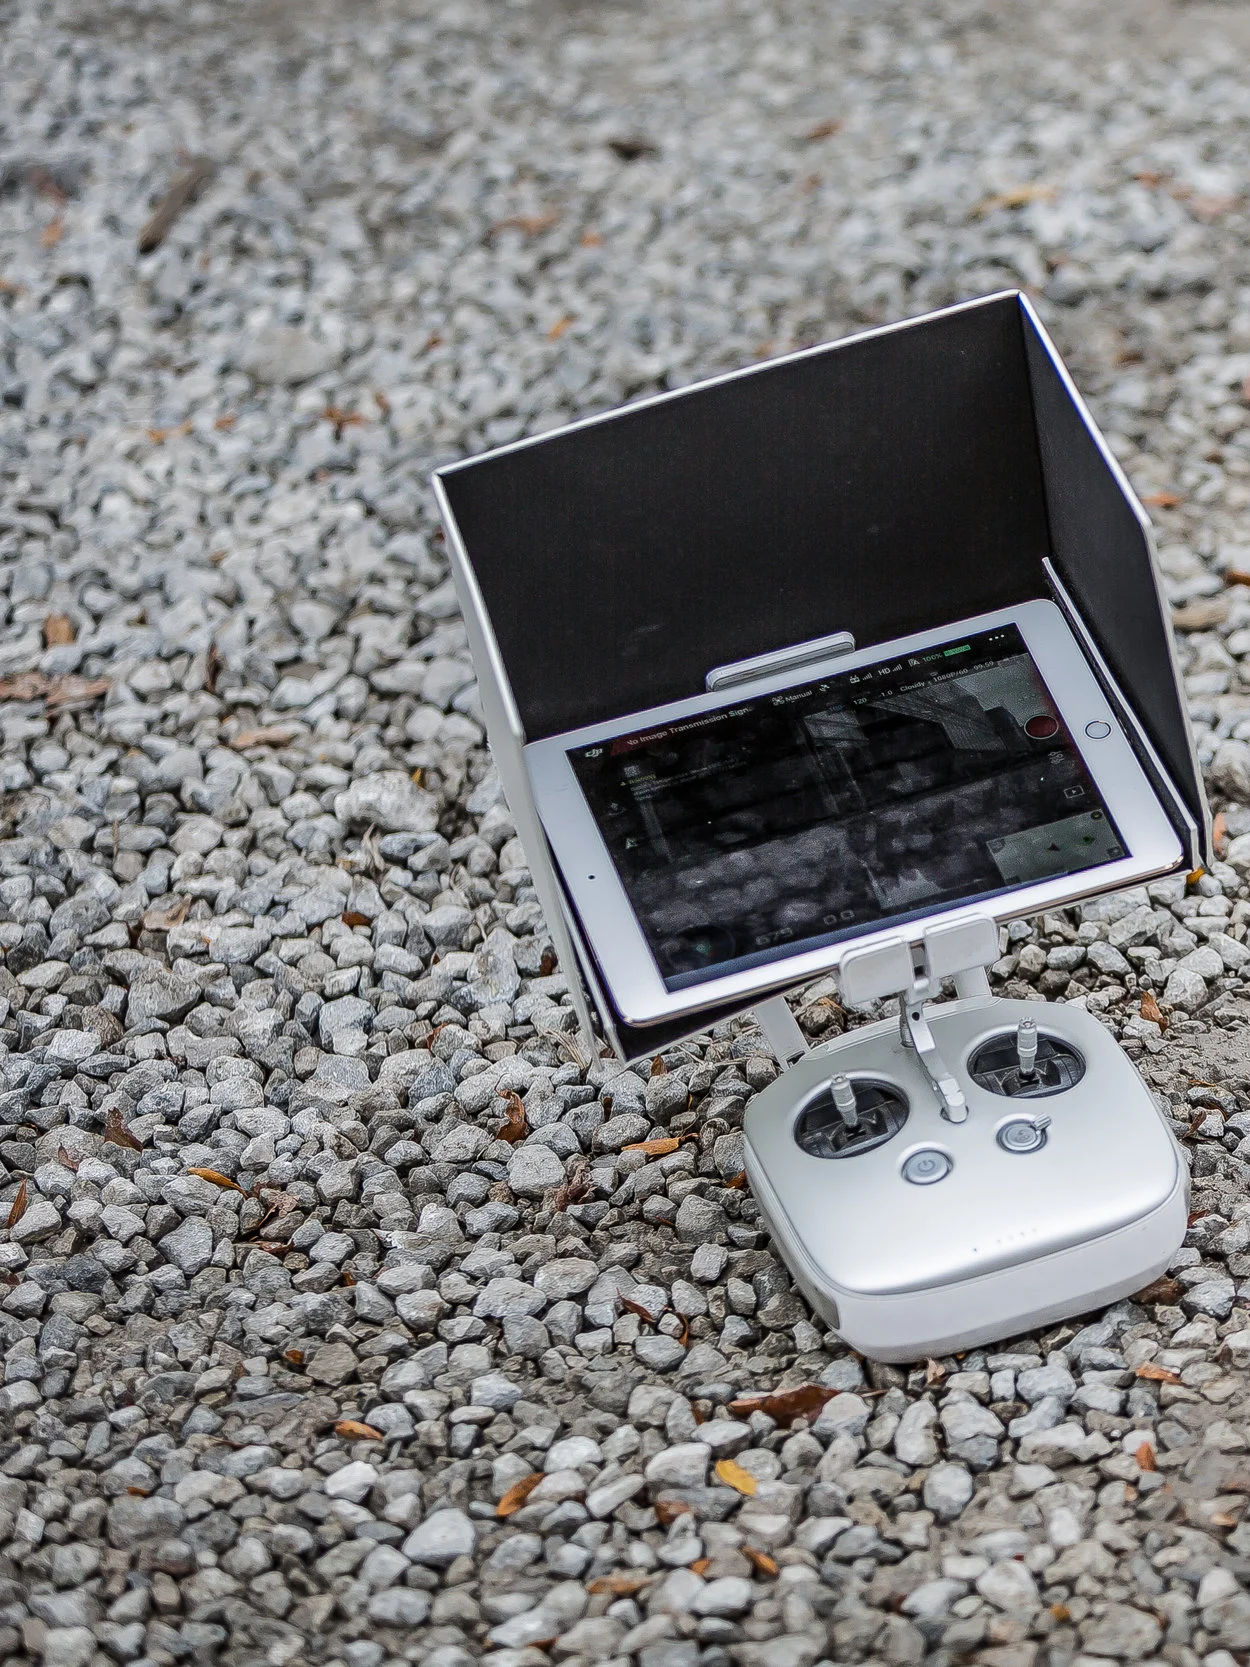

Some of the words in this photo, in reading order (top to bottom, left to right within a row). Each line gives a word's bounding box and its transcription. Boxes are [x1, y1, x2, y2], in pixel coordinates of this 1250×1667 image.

[878, 667, 891, 676] HD
[900, 681, 925, 692] Cloudy
[785, 690, 813, 703] Manual
[639, 730, 668, 743] Image
[669, 713, 728, 735] Transmission
